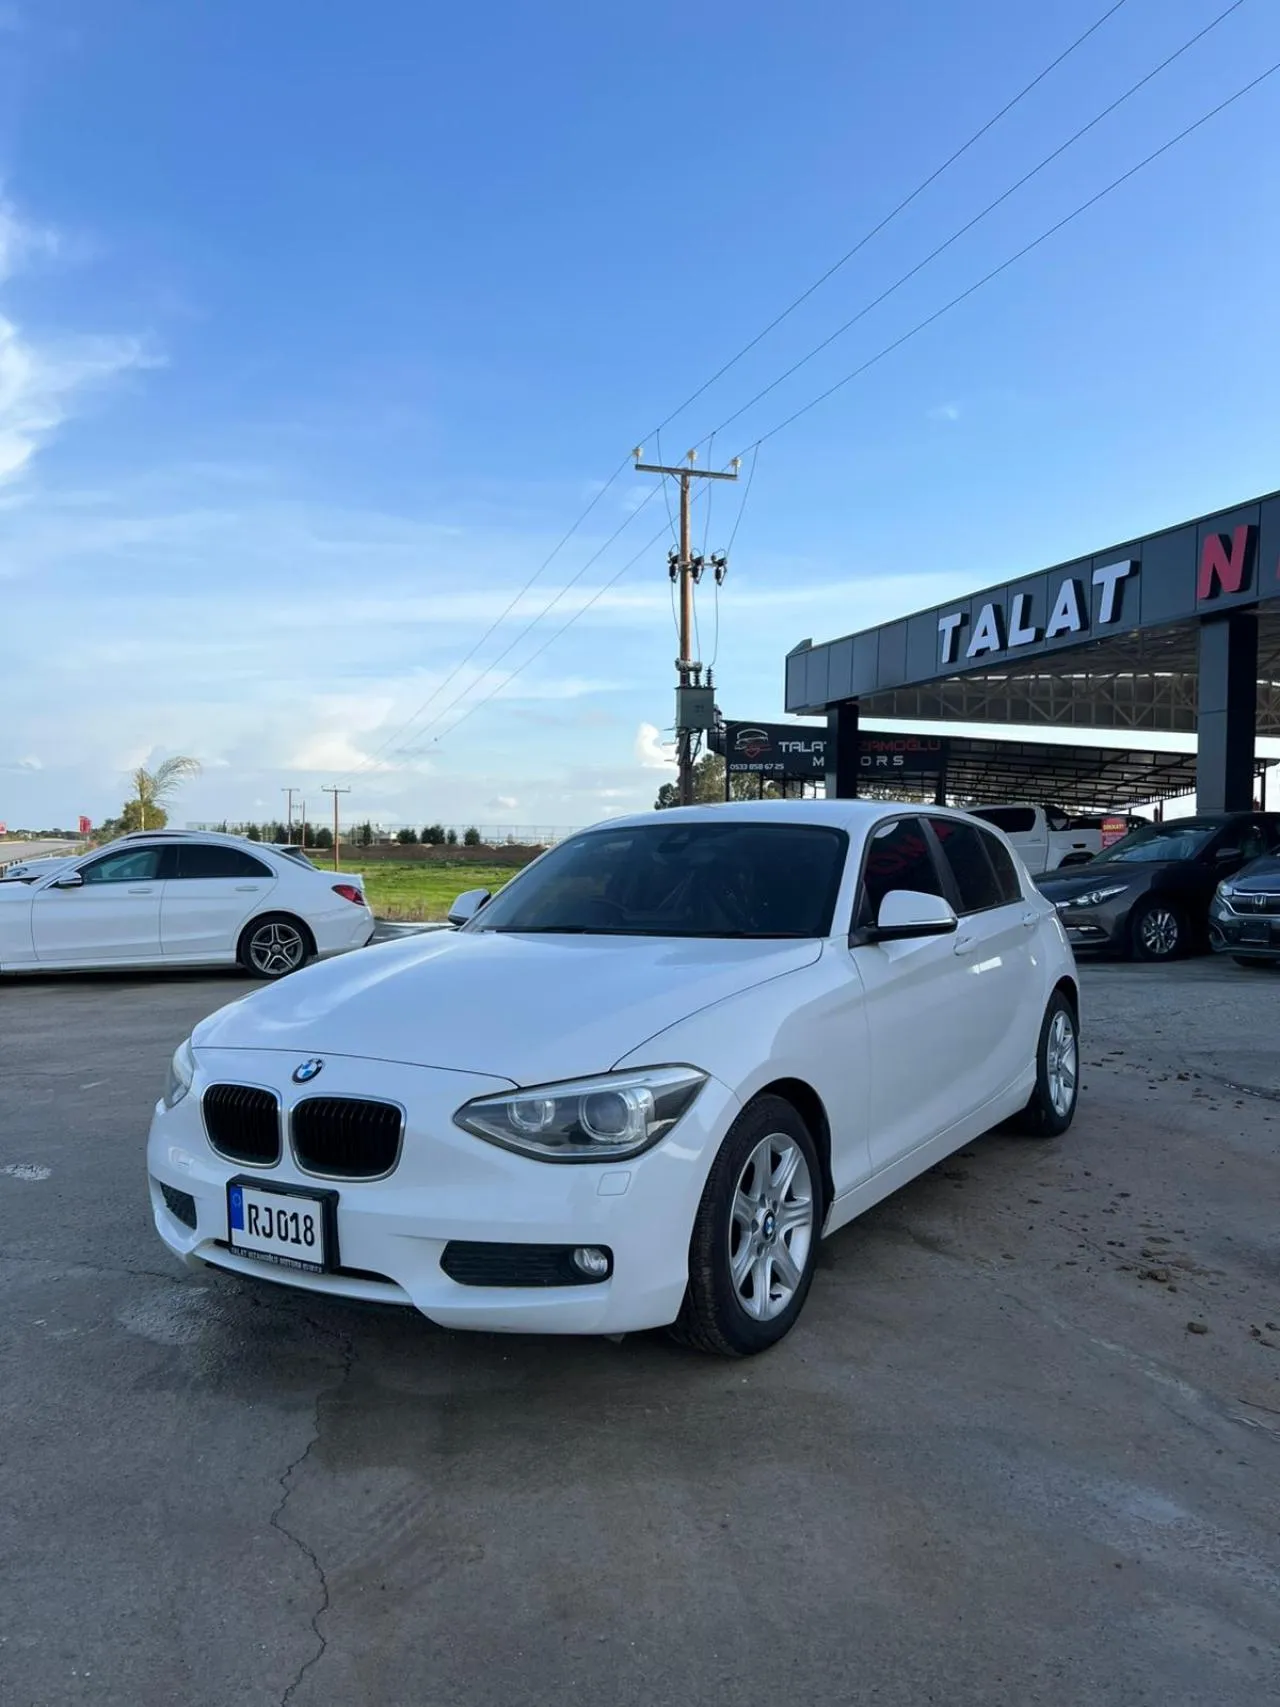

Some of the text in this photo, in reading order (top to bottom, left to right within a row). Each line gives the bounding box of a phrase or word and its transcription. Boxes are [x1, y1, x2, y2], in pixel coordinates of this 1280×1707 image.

[938, 559, 1132, 664] TALAT
[778, 741, 827, 753] TALA
[247, 1203, 315, 1247] RJ018
